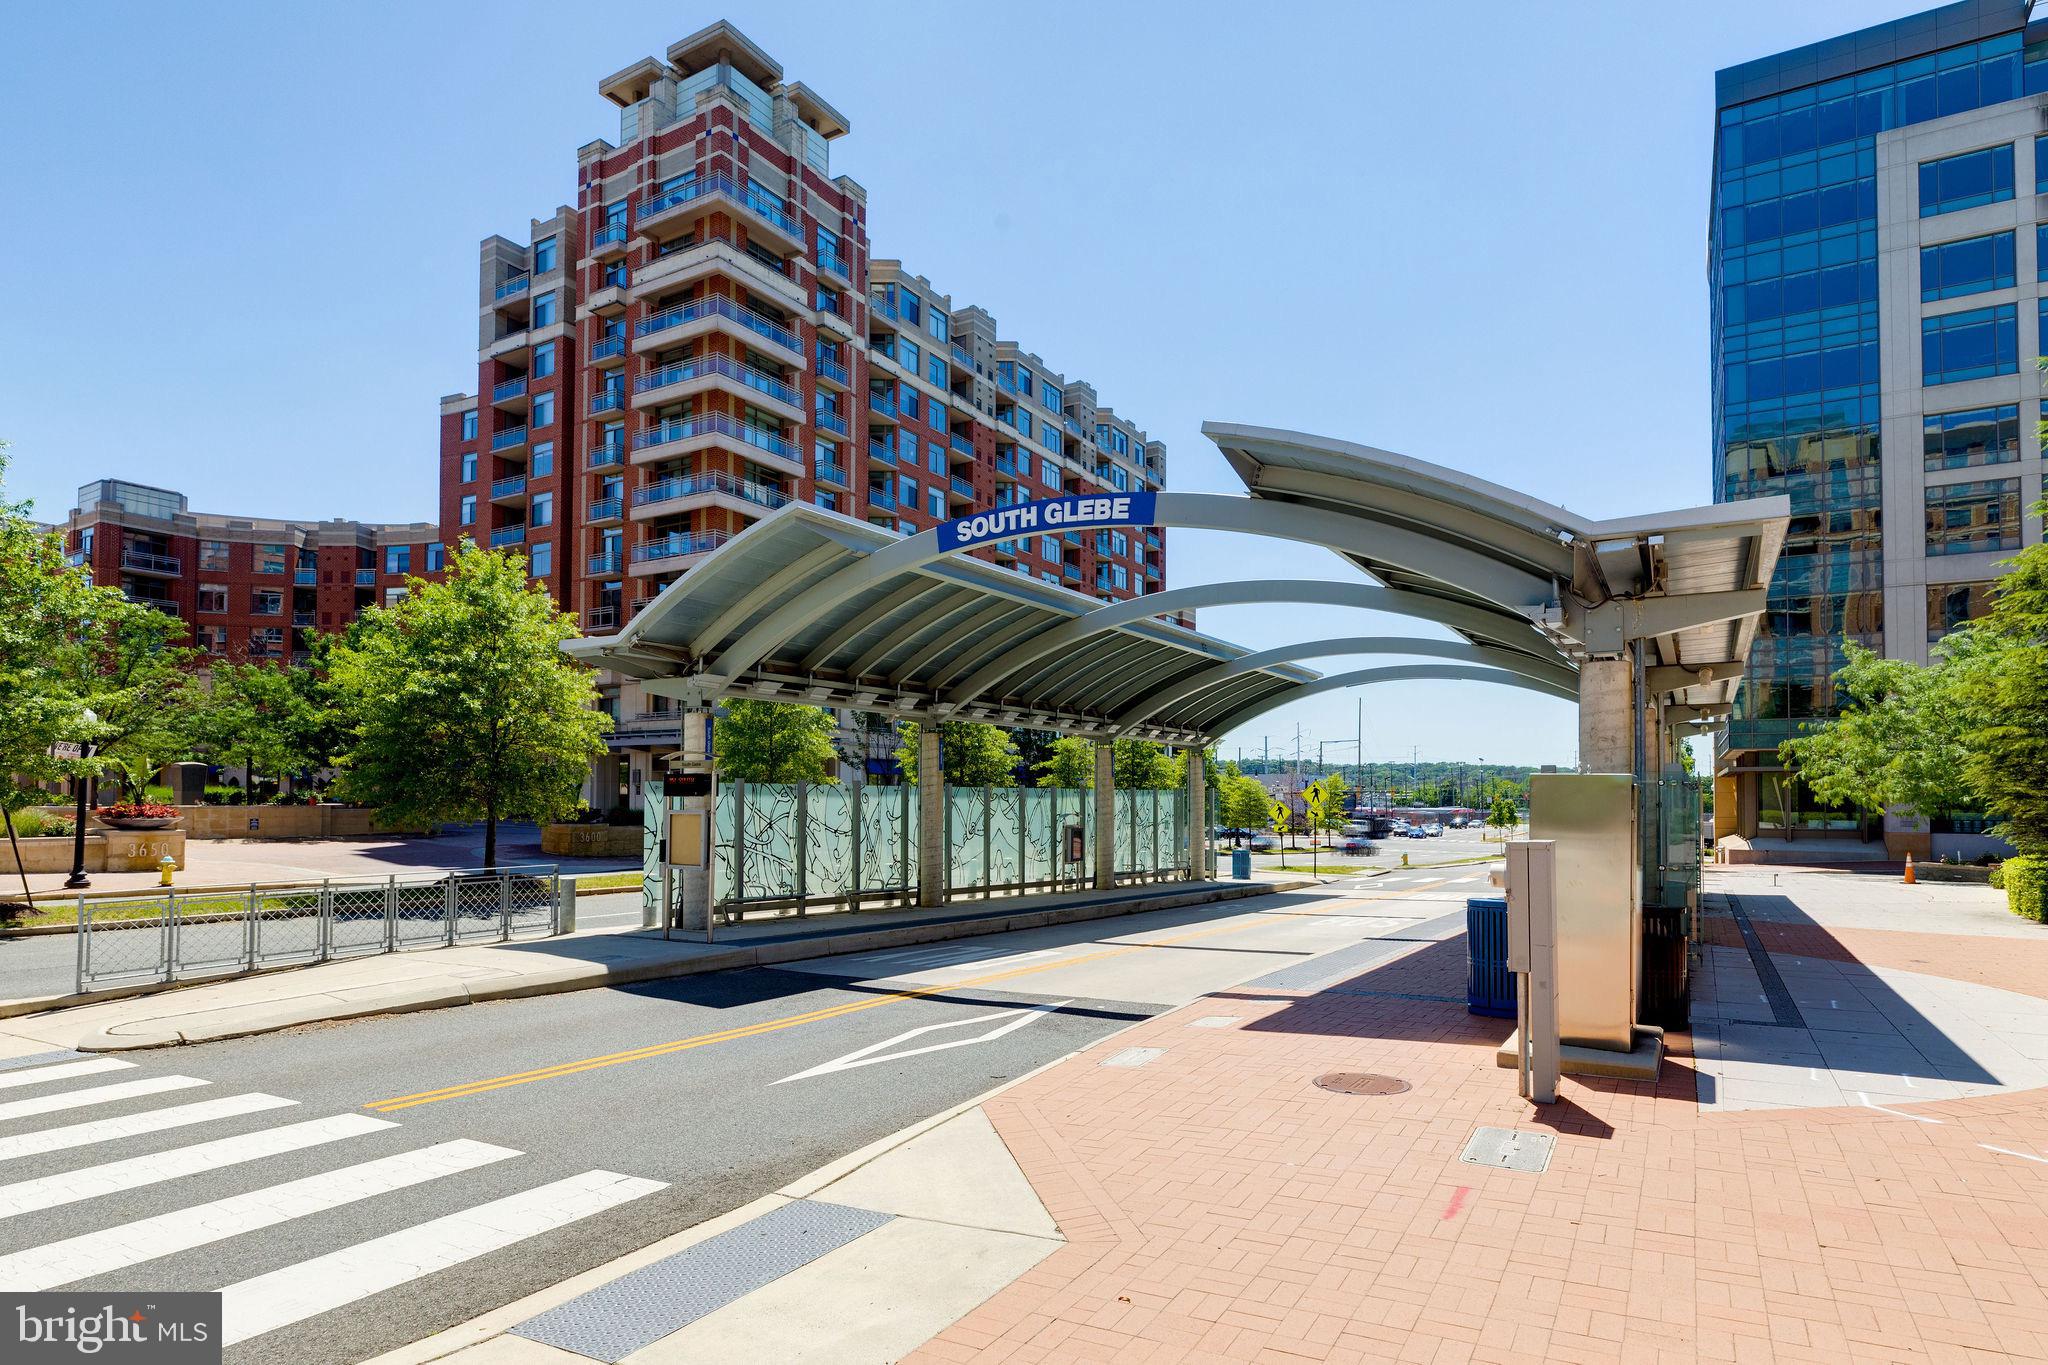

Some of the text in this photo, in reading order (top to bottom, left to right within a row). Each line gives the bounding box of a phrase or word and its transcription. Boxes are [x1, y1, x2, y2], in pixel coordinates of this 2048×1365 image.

[957, 498, 1131, 542] SOUTH GLEBE
[580, 832, 600, 842] 3600
[128, 842, 168, 857] 3650
